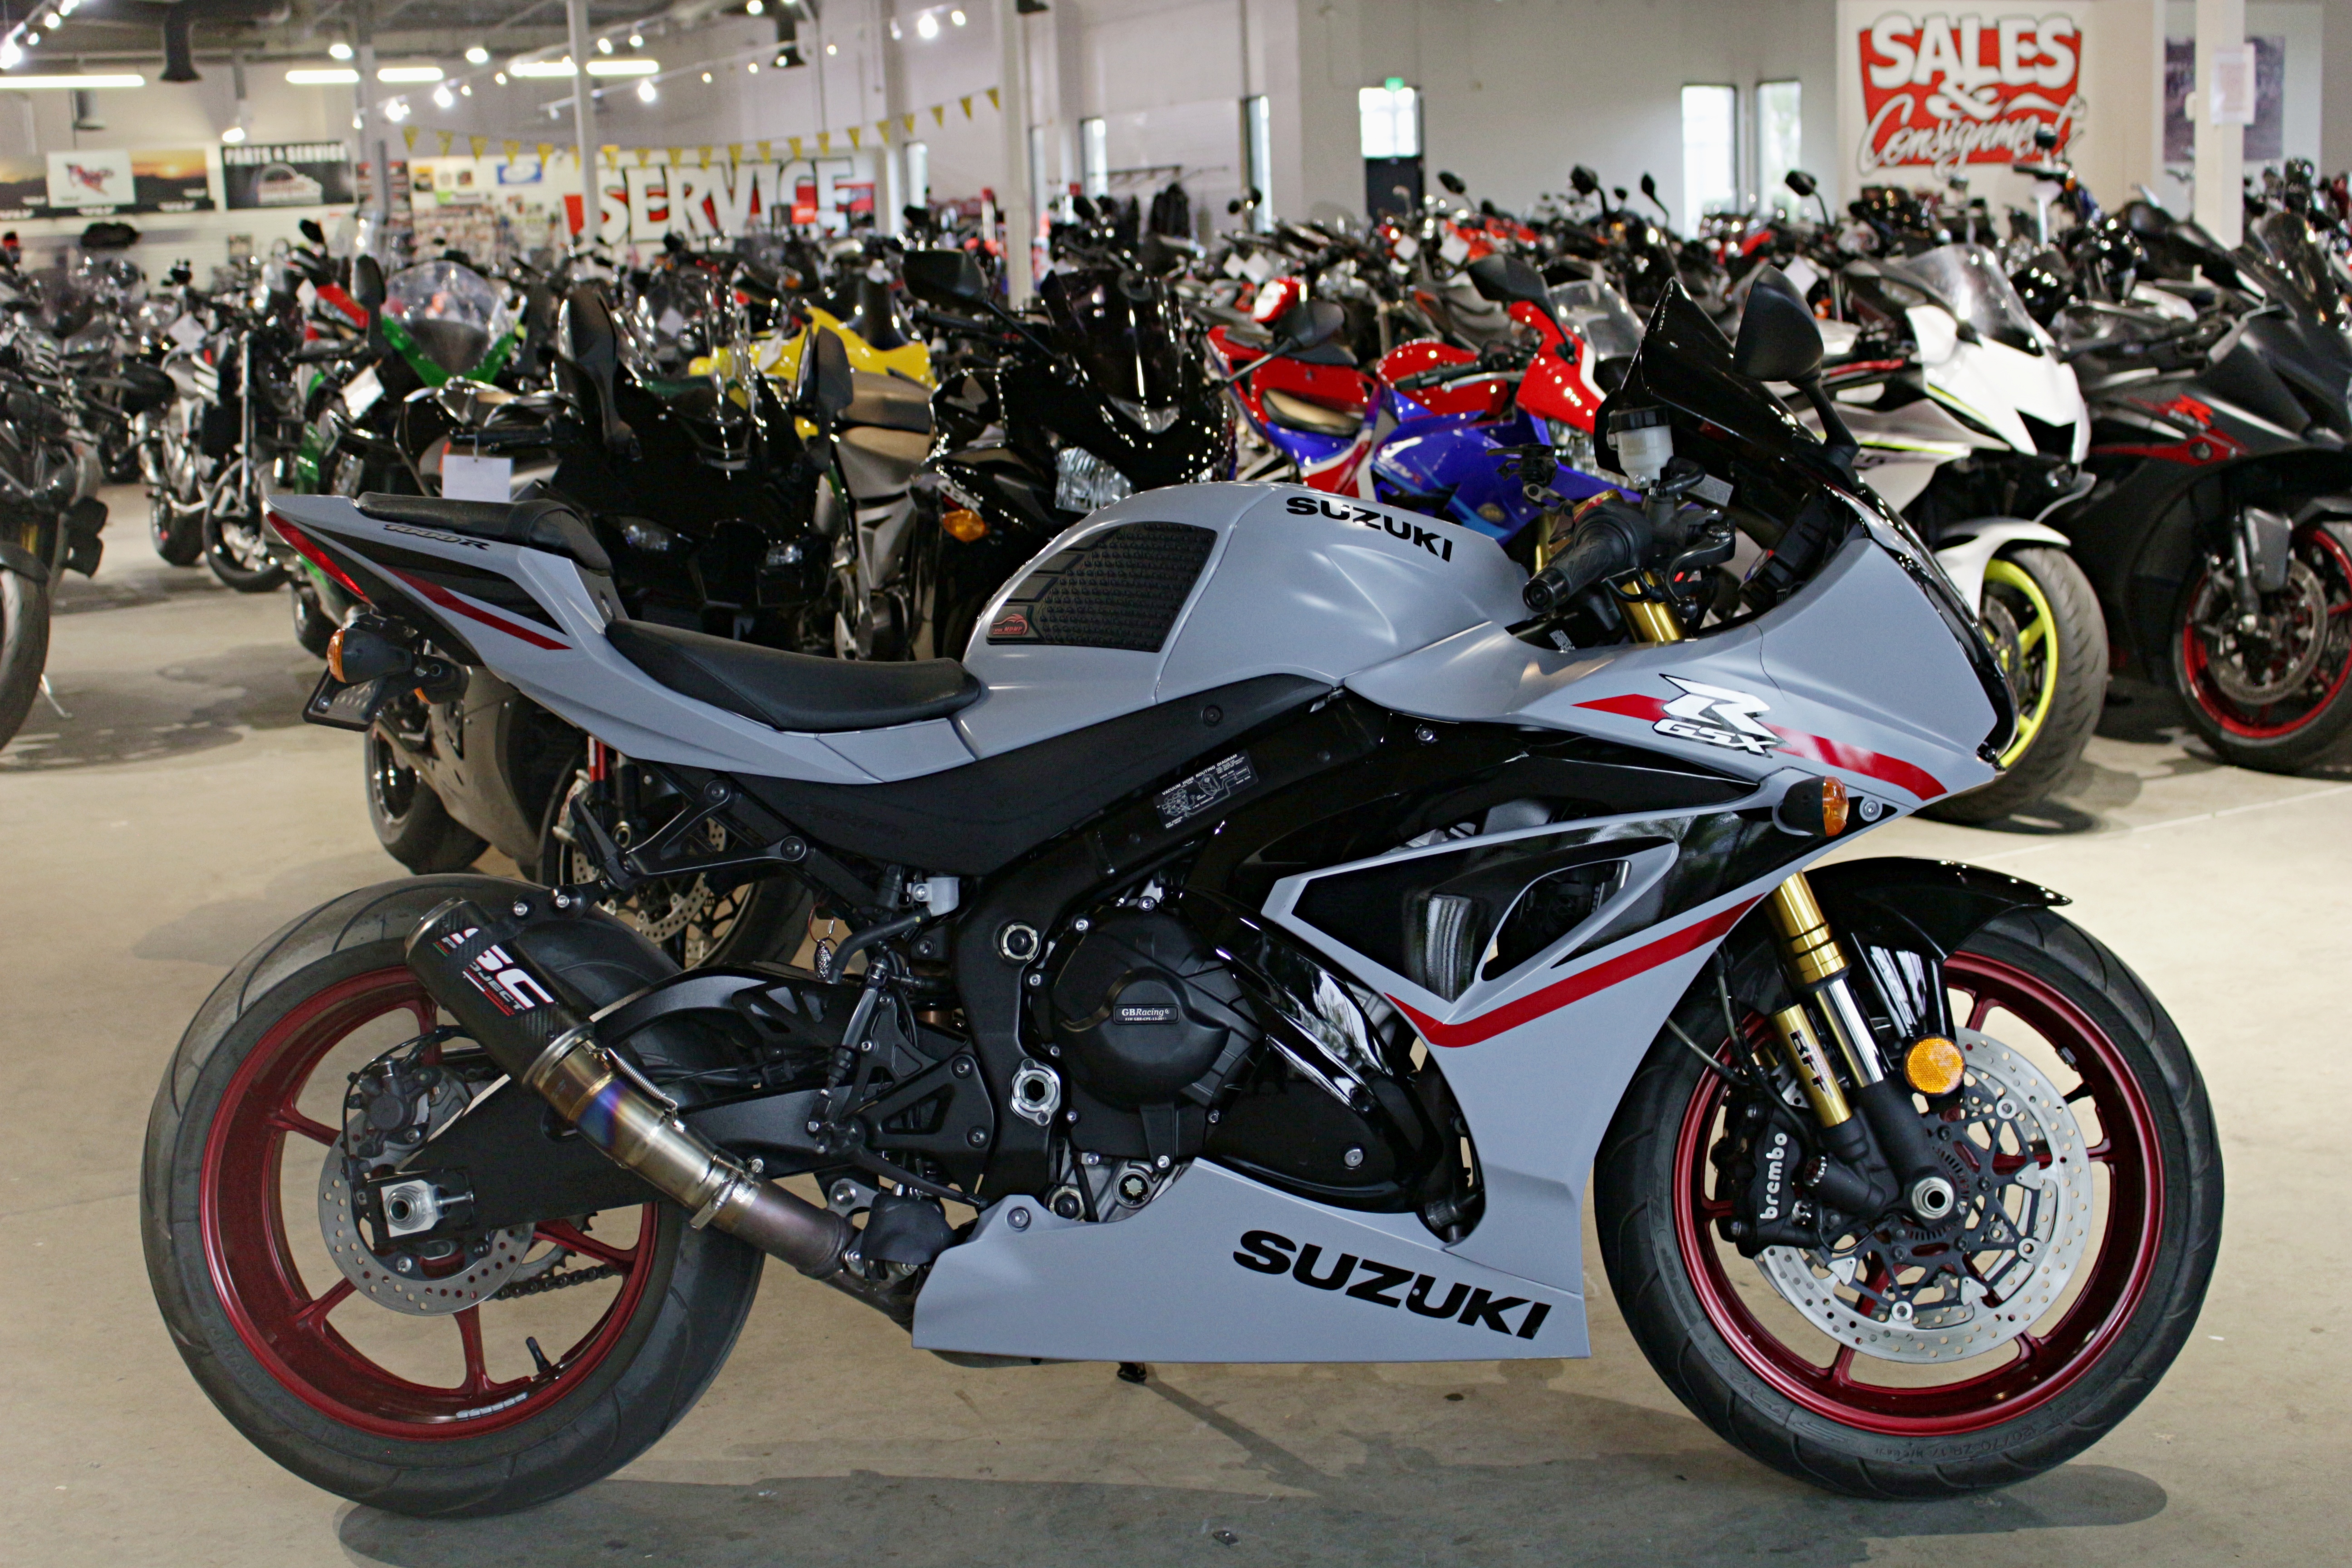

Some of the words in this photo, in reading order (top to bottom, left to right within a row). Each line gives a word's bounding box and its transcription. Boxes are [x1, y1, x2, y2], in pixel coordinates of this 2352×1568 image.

[1867, 11, 2078, 89] SALES
[1926, 78, 2008, 121] &
[1286, 496, 1453, 563] SUZUKI
[1653, 718, 1772, 757] GSX
[1162, 784, 1181, 795] VACUUM
[1182, 776, 1194, 785] HOSE
[1196, 765, 1215, 778] ROUTING
[1217, 754, 1238, 767] DIAGRAM
[1788, 1029, 1833, 1099] BFF
[1759, 1132, 1788, 1220] brembo
[1233, 1230, 1552, 1340] SUZUKI
